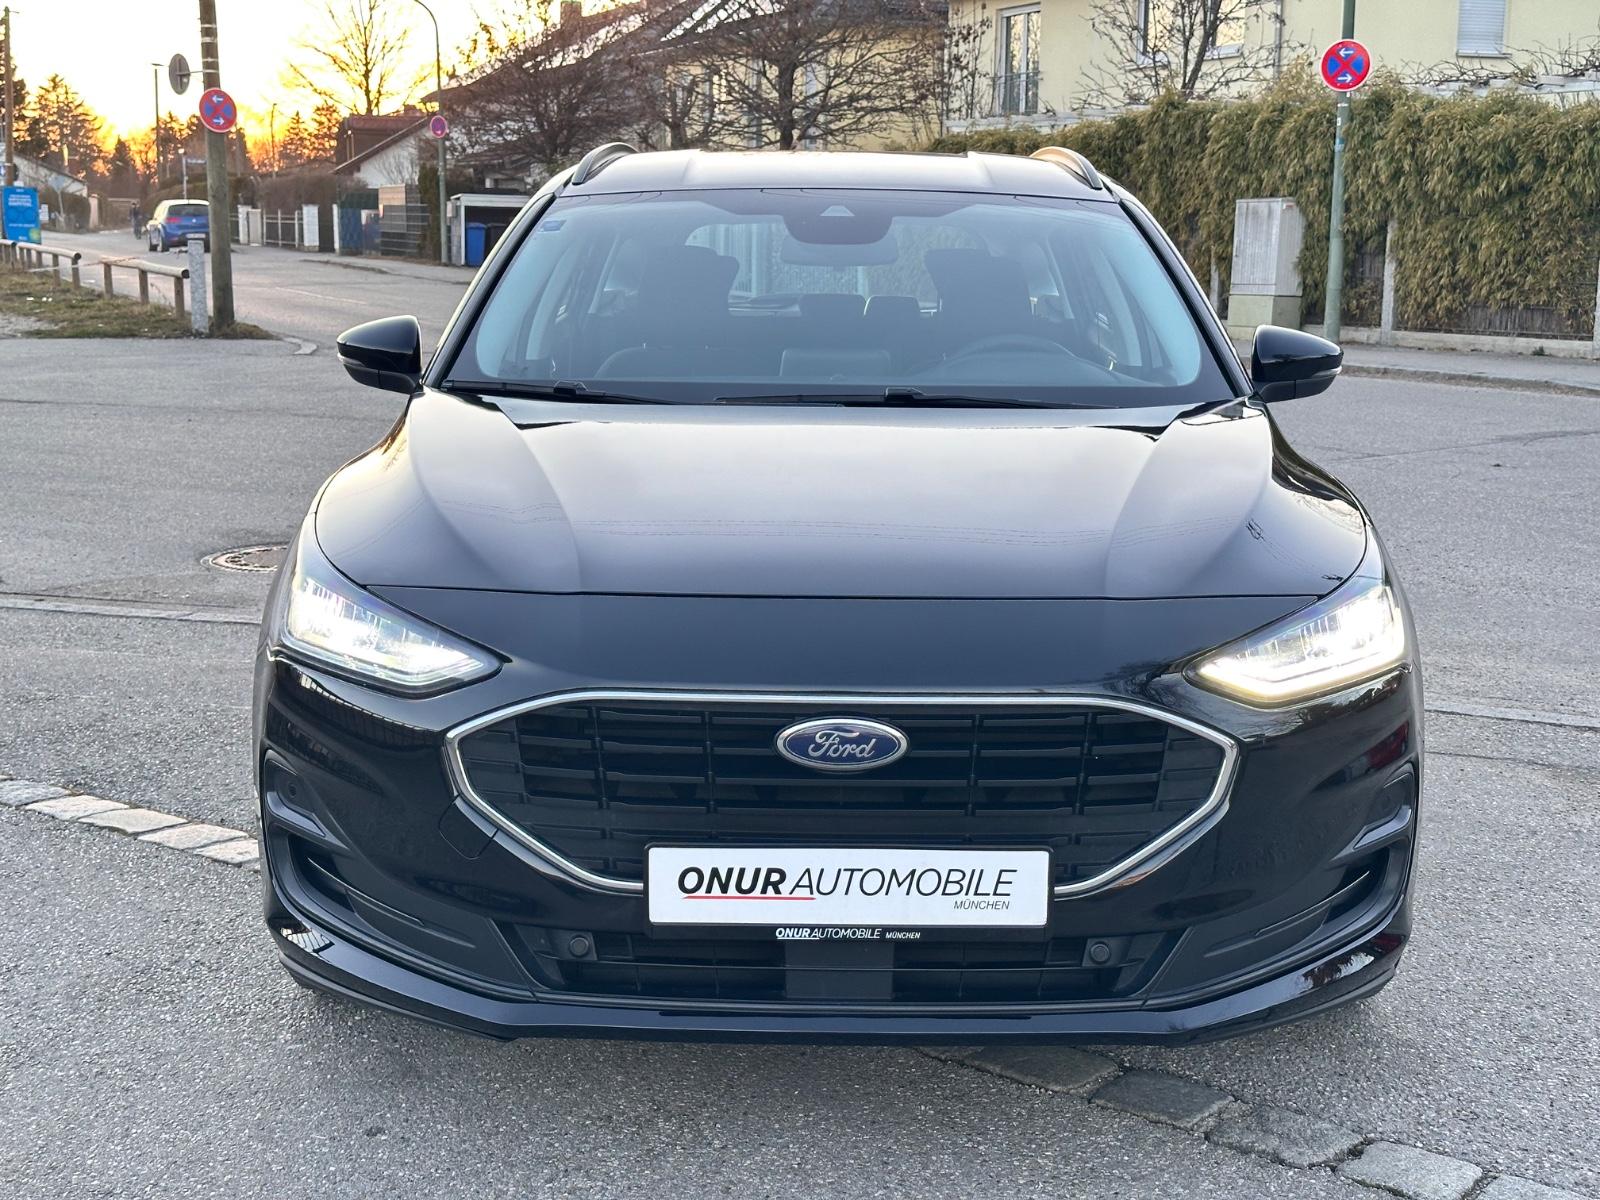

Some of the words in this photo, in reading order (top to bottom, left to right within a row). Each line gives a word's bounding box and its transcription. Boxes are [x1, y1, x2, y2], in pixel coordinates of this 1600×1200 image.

[807, 730, 877, 758] Ford
[677, 866, 787, 895] ONUR
[789, 867, 1018, 897] AUTOMOBILE
[953, 898, 1010, 910] MÜNCHEN
[775, 927, 811, 938] ONUR
[811, 928, 882, 939] AUTOMOBILE
[885, 930, 921, 939] MÜNCHEN
